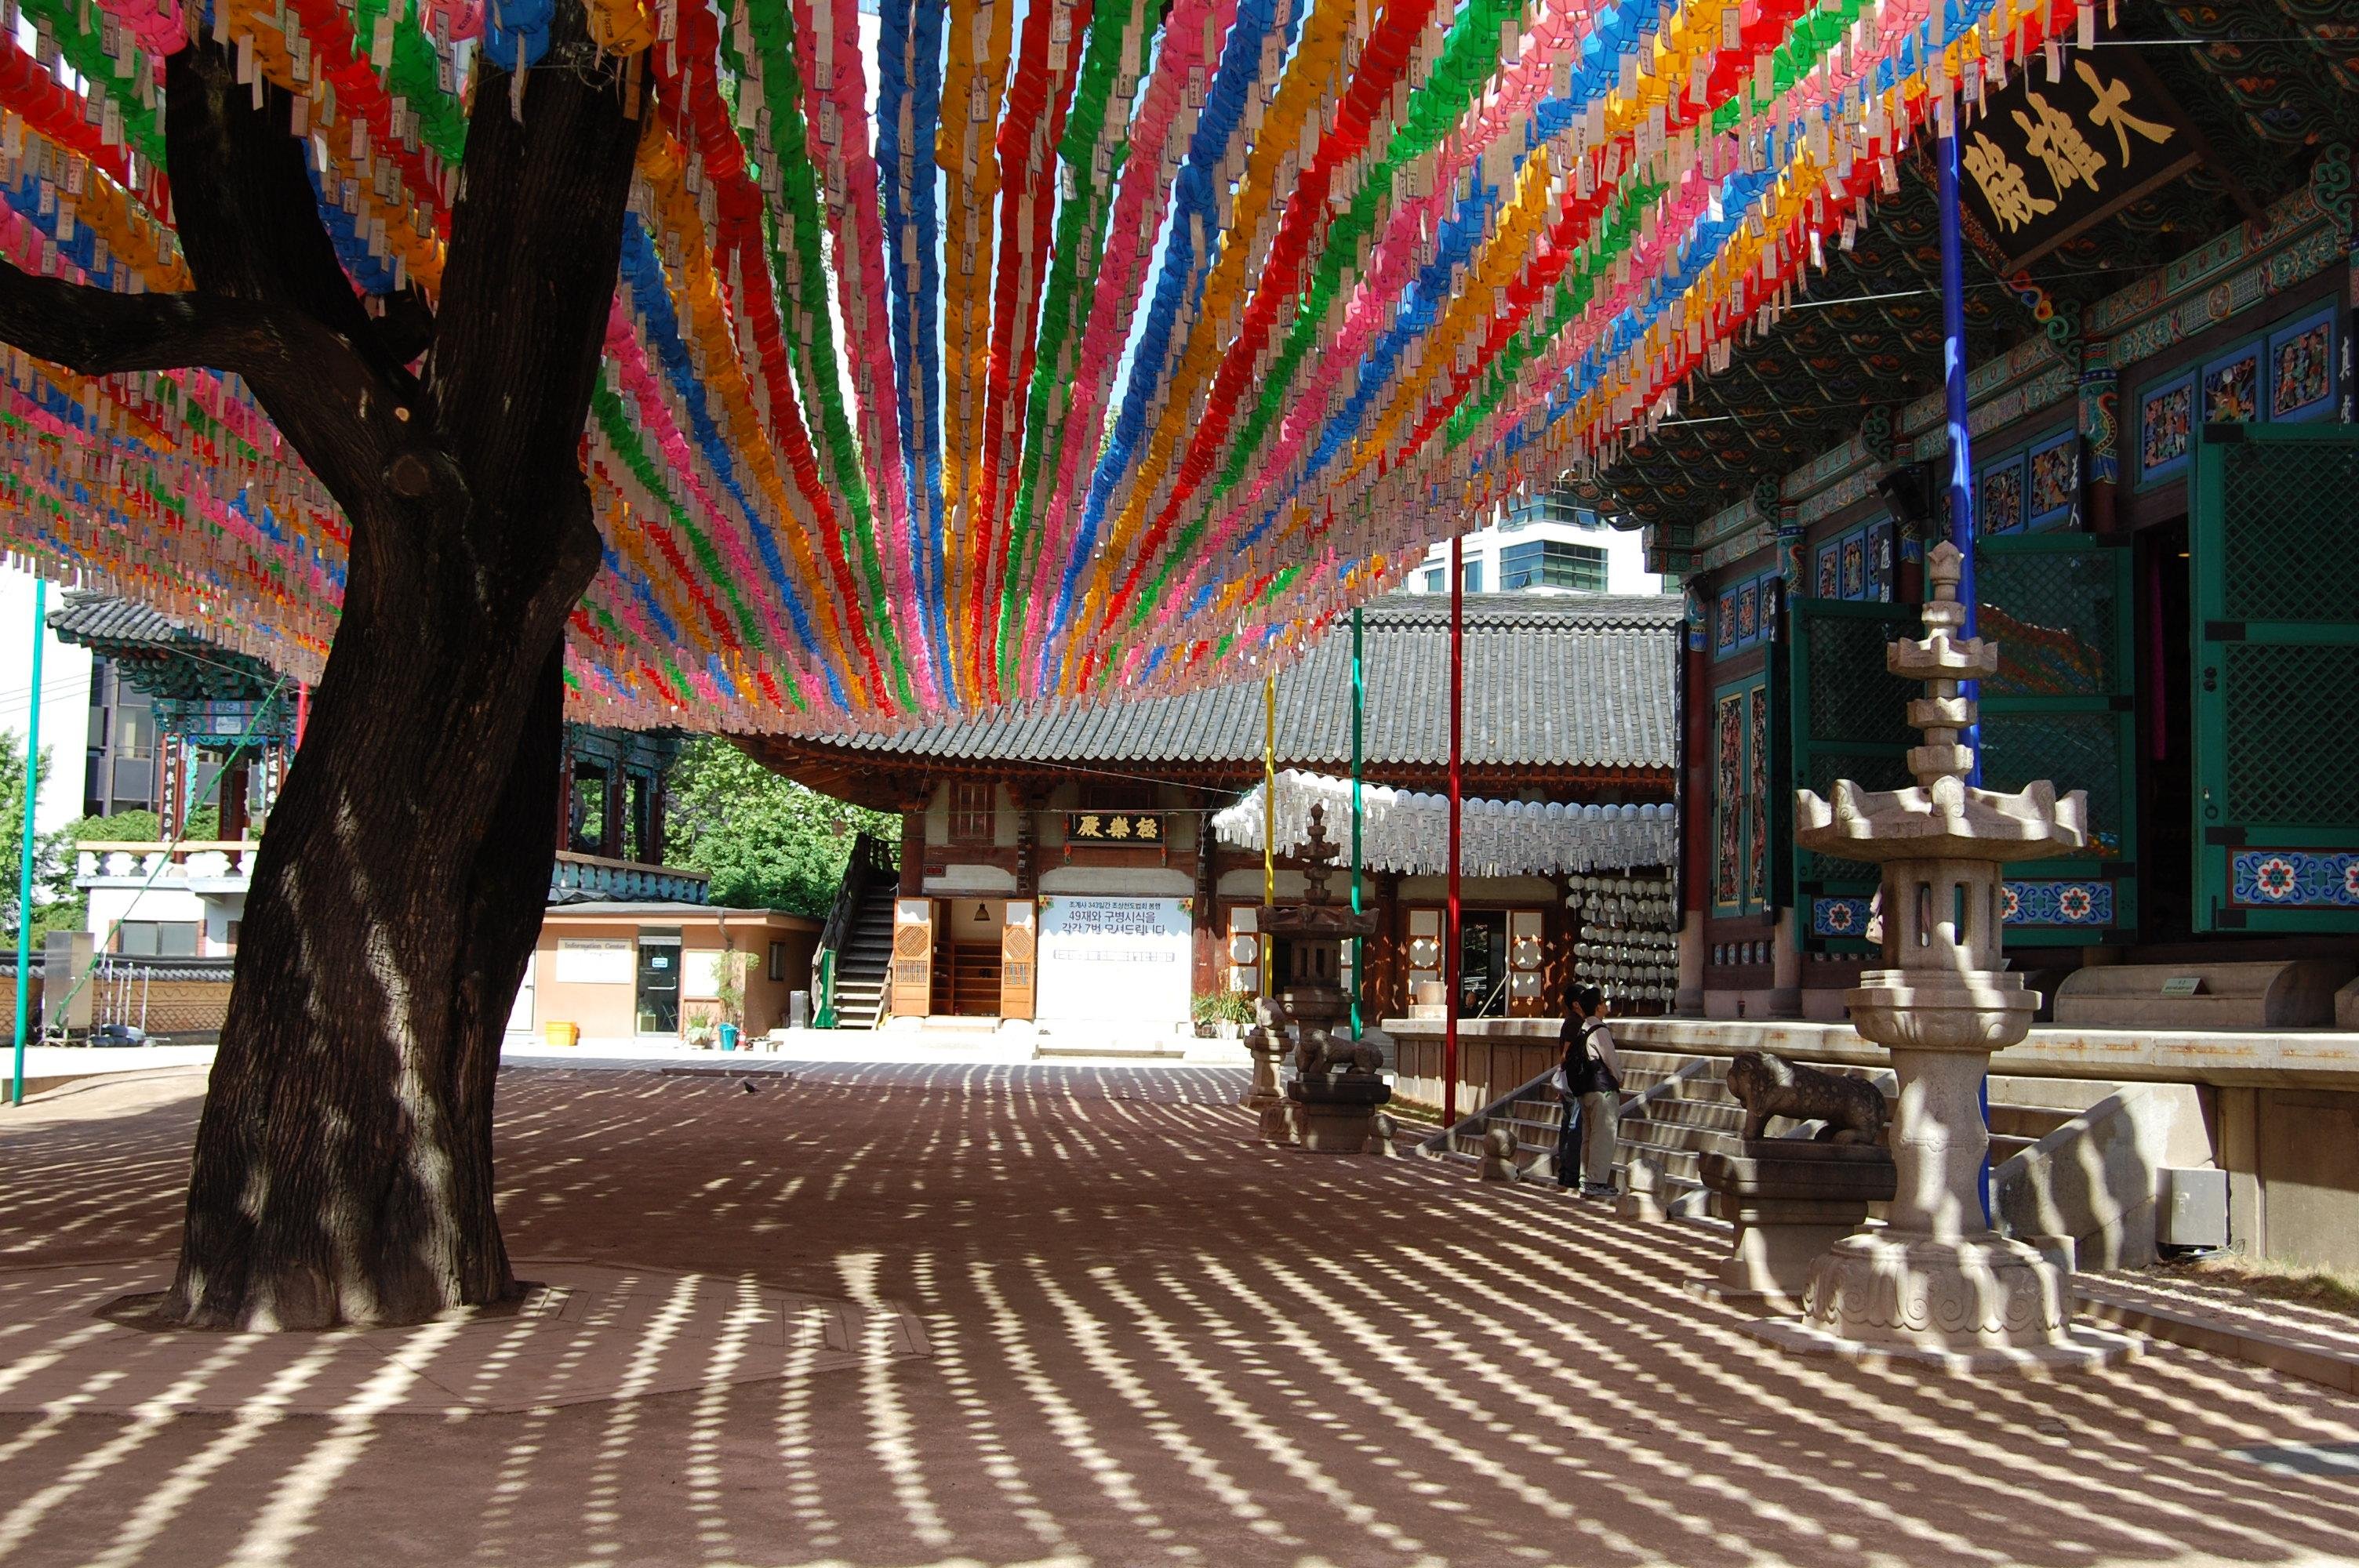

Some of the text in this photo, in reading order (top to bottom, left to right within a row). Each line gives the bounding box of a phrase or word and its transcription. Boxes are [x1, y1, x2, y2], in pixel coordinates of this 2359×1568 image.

[1962, 59, 2177, 234] 大雄殿
[1069, 911, 1156, 924] 49재와 구병시식을
[1062, 923, 1082, 935] 각각
[1085, 924, 1101, 935] 7번
